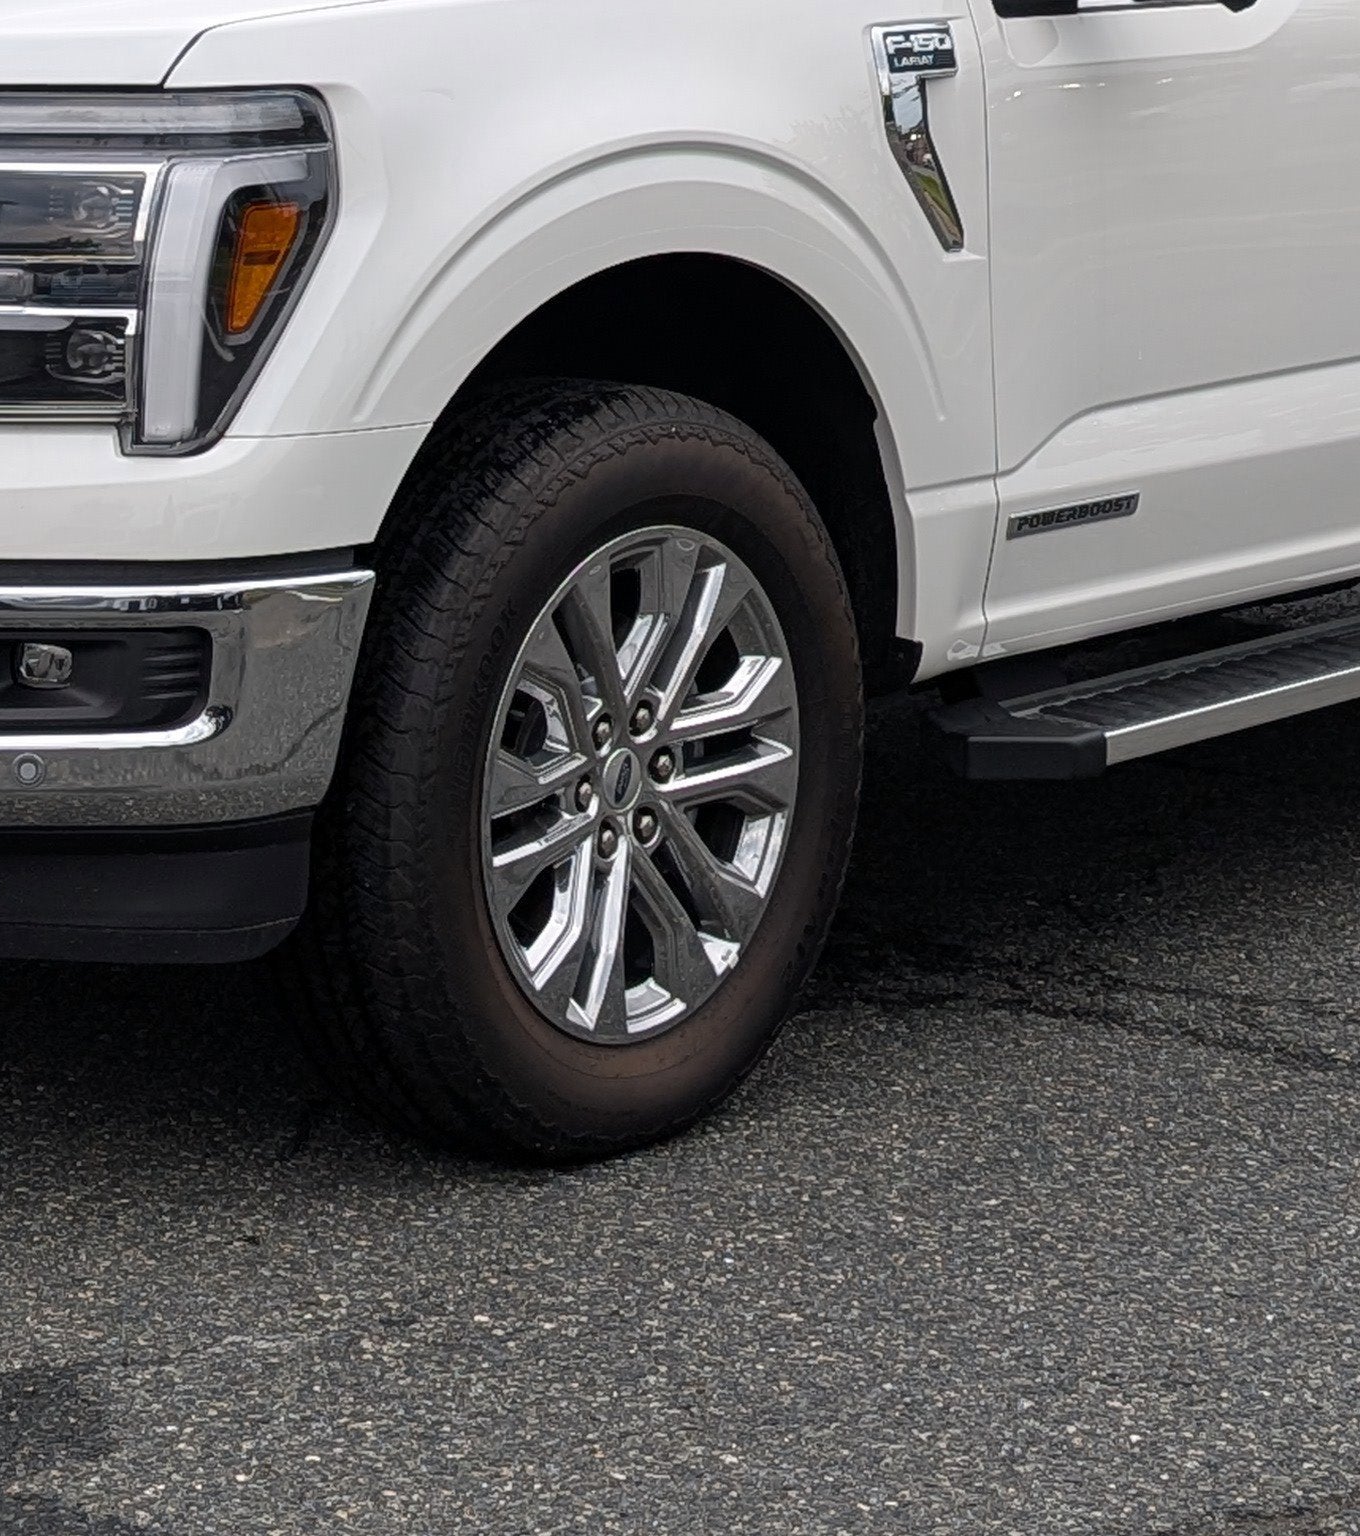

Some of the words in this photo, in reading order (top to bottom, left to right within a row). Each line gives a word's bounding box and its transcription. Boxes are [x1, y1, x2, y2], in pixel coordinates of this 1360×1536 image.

[885, 32, 952, 55] F-150
[893, 55, 934, 67] LARIAT
[1017, 494, 1136, 531] POWERBOOST
